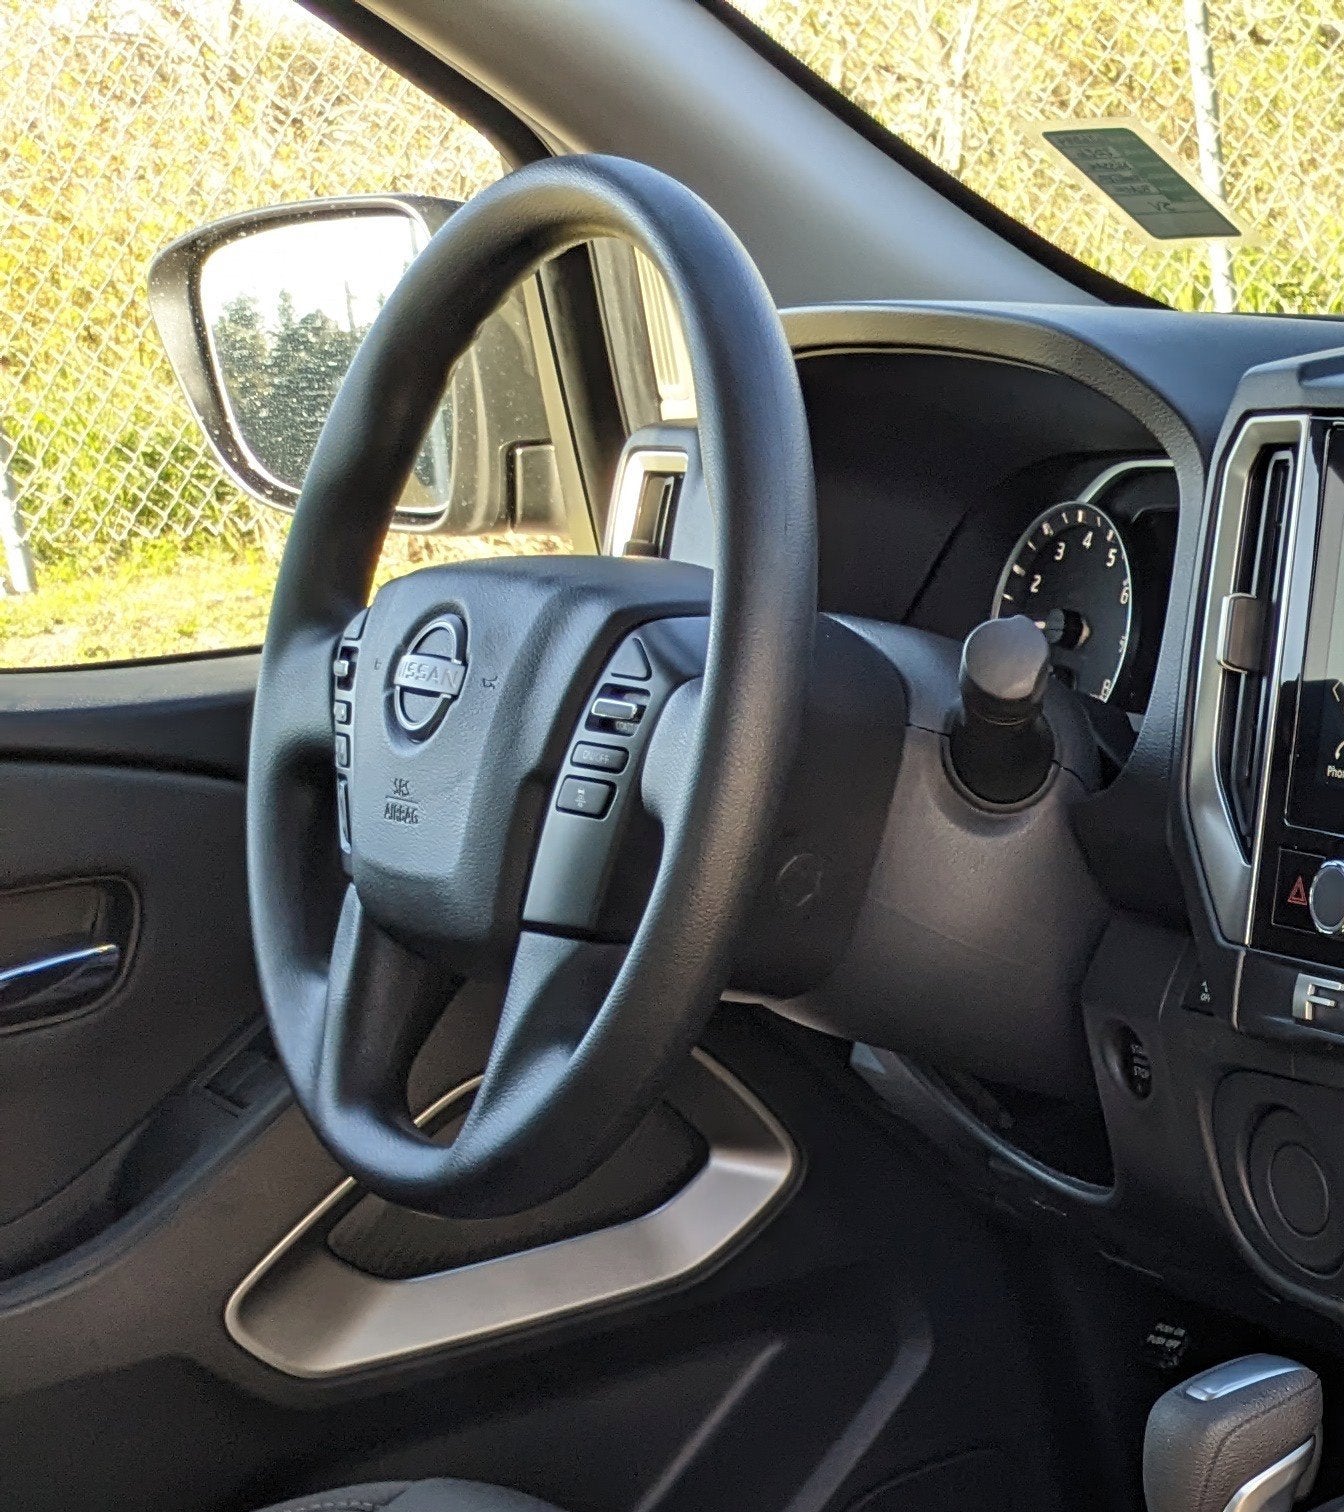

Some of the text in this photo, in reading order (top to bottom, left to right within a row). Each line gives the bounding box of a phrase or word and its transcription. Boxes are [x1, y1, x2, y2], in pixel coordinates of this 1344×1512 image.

[1082, 531, 1093, 549] 4
[1055, 542, 1065, 560] 3
[1106, 548, 1117, 567] 5
[1030, 574, 1042, 593] 2
[1120, 586, 1130, 605] 6
